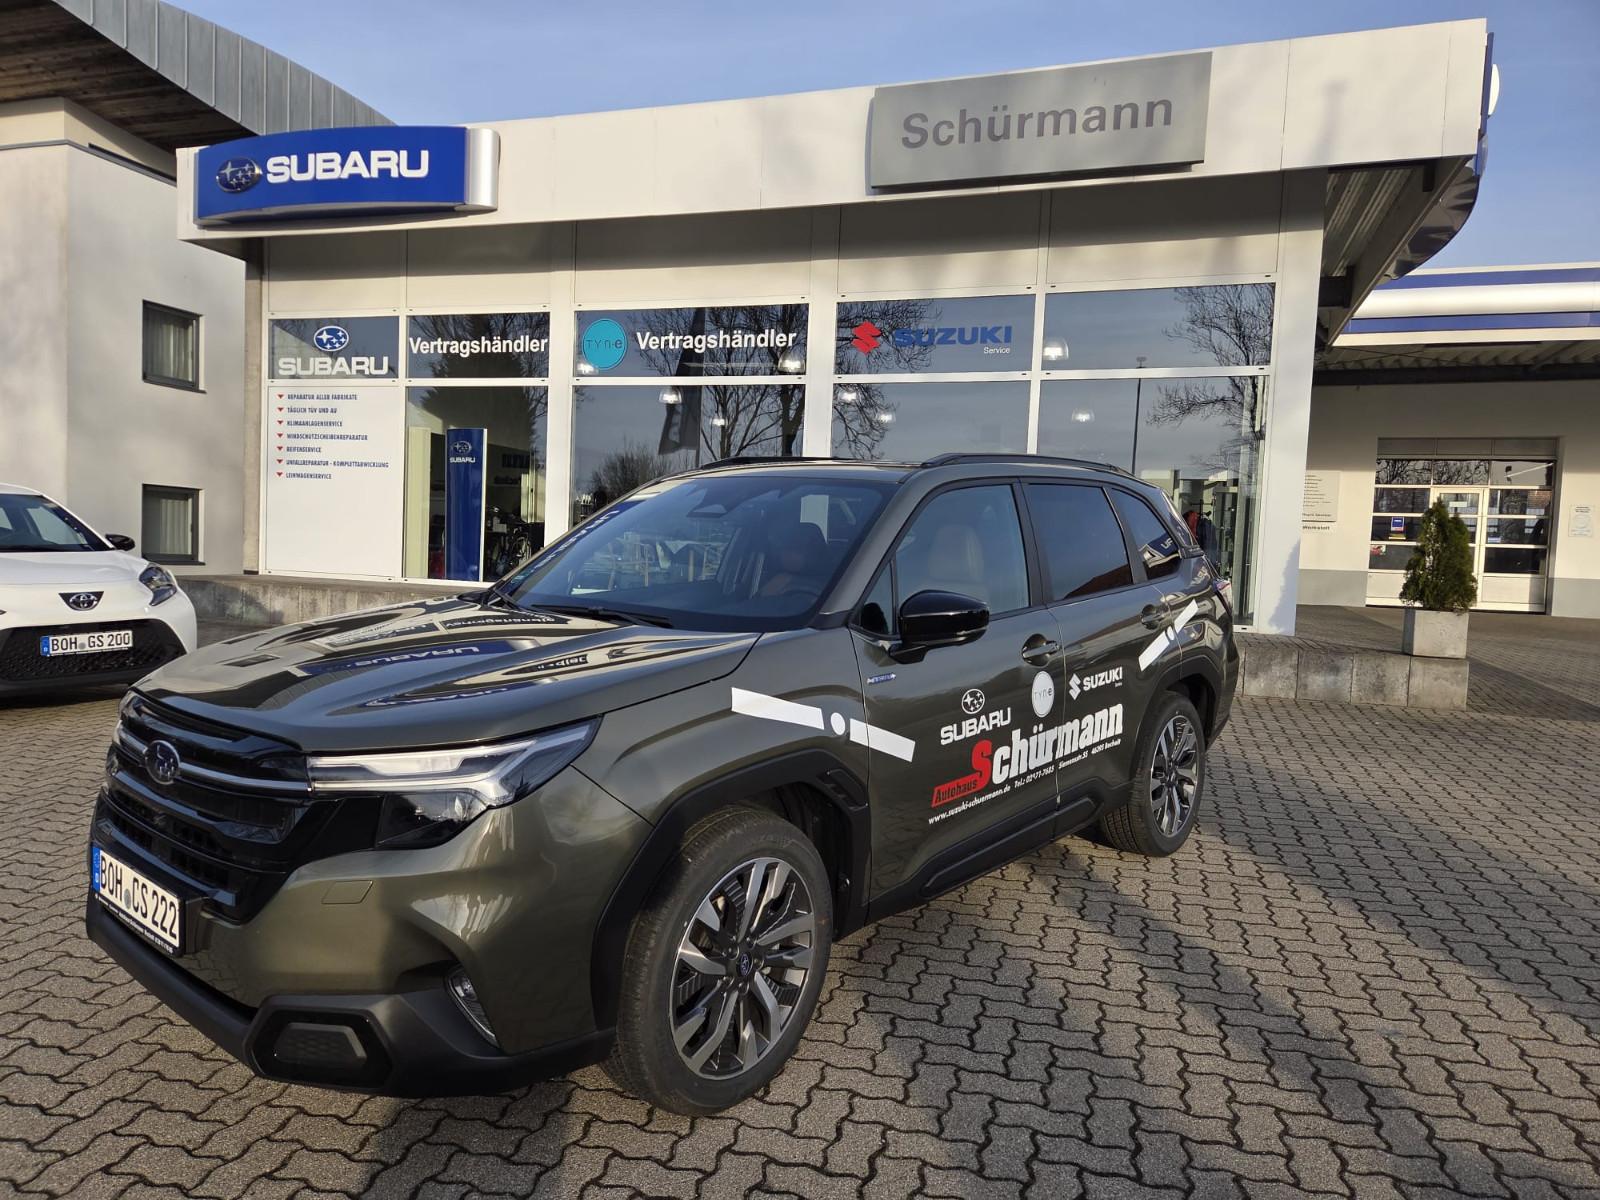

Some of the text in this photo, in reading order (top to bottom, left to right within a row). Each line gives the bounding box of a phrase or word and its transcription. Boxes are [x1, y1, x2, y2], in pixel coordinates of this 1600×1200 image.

[902, 98, 1172, 149] Schürmann
[266, 150, 429, 184] SUBARU
[409, 335, 548, 358] Vertragshändler
[636, 329, 797, 353] Vertragshändler
[894, 325, 1013, 347] SUZUKI
[983, 346, 1011, 354] Service
[278, 356, 389, 376] SUBARU
[51, 632, 130, 652] BOH GS 200
[1083, 666, 1123, 691] SUZUKI
[940, 707, 1011, 745] SUBARU
[971, 703, 1124, 788] Schürmann
[935, 778, 978, 803] Autohaus
[100, 855, 123, 902] BOH
[132, 877, 148, 919] CS
[151, 889, 177, 940] 222
